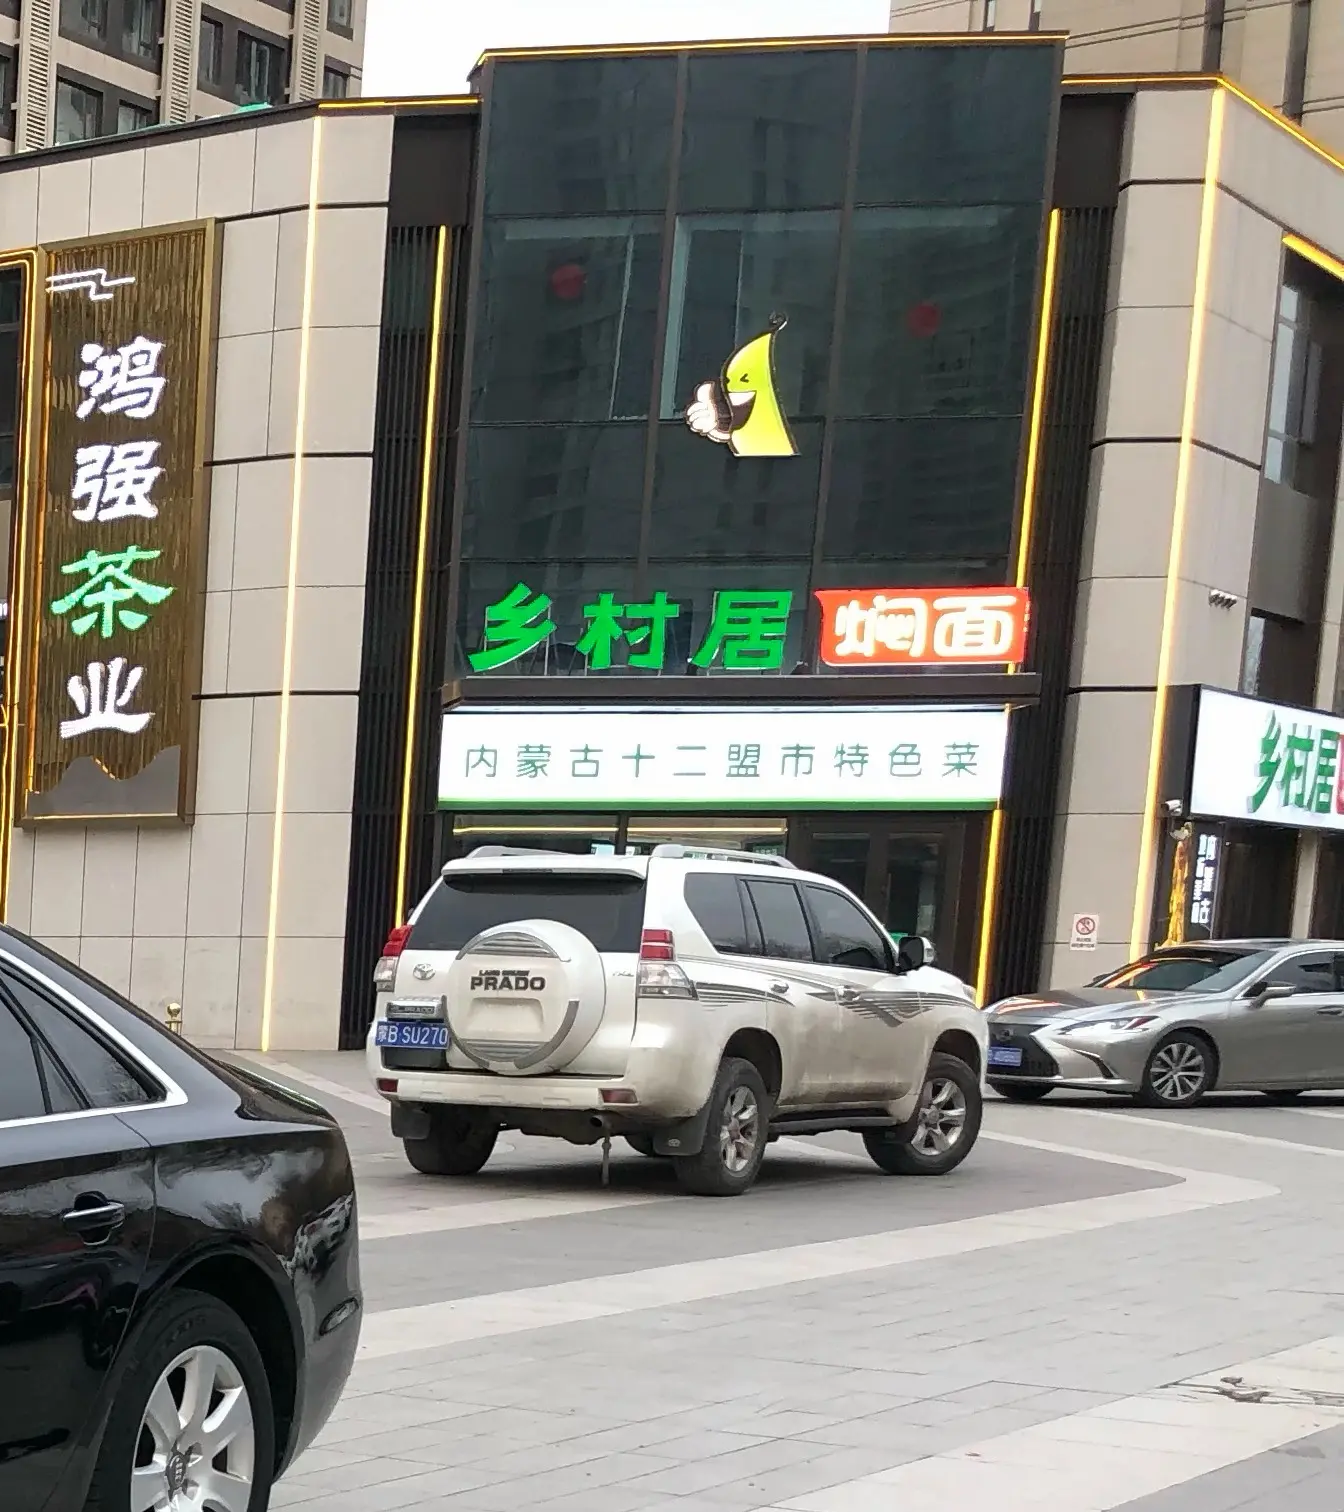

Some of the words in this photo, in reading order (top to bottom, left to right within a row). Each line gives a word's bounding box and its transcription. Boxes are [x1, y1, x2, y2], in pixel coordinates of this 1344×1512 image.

[51, 335, 178, 739] 鸿强茶业
[467, 581, 793, 673] 乡村居
[834, 595, 1017, 657] 焖面
[464, 742, 981, 779] 内蒙古十二盟市特色菜
[1246, 709, 1338, 814] 乡村居
[470, 976, 545, 991] PRADO
[402, 1026, 449, 1046] SU270
